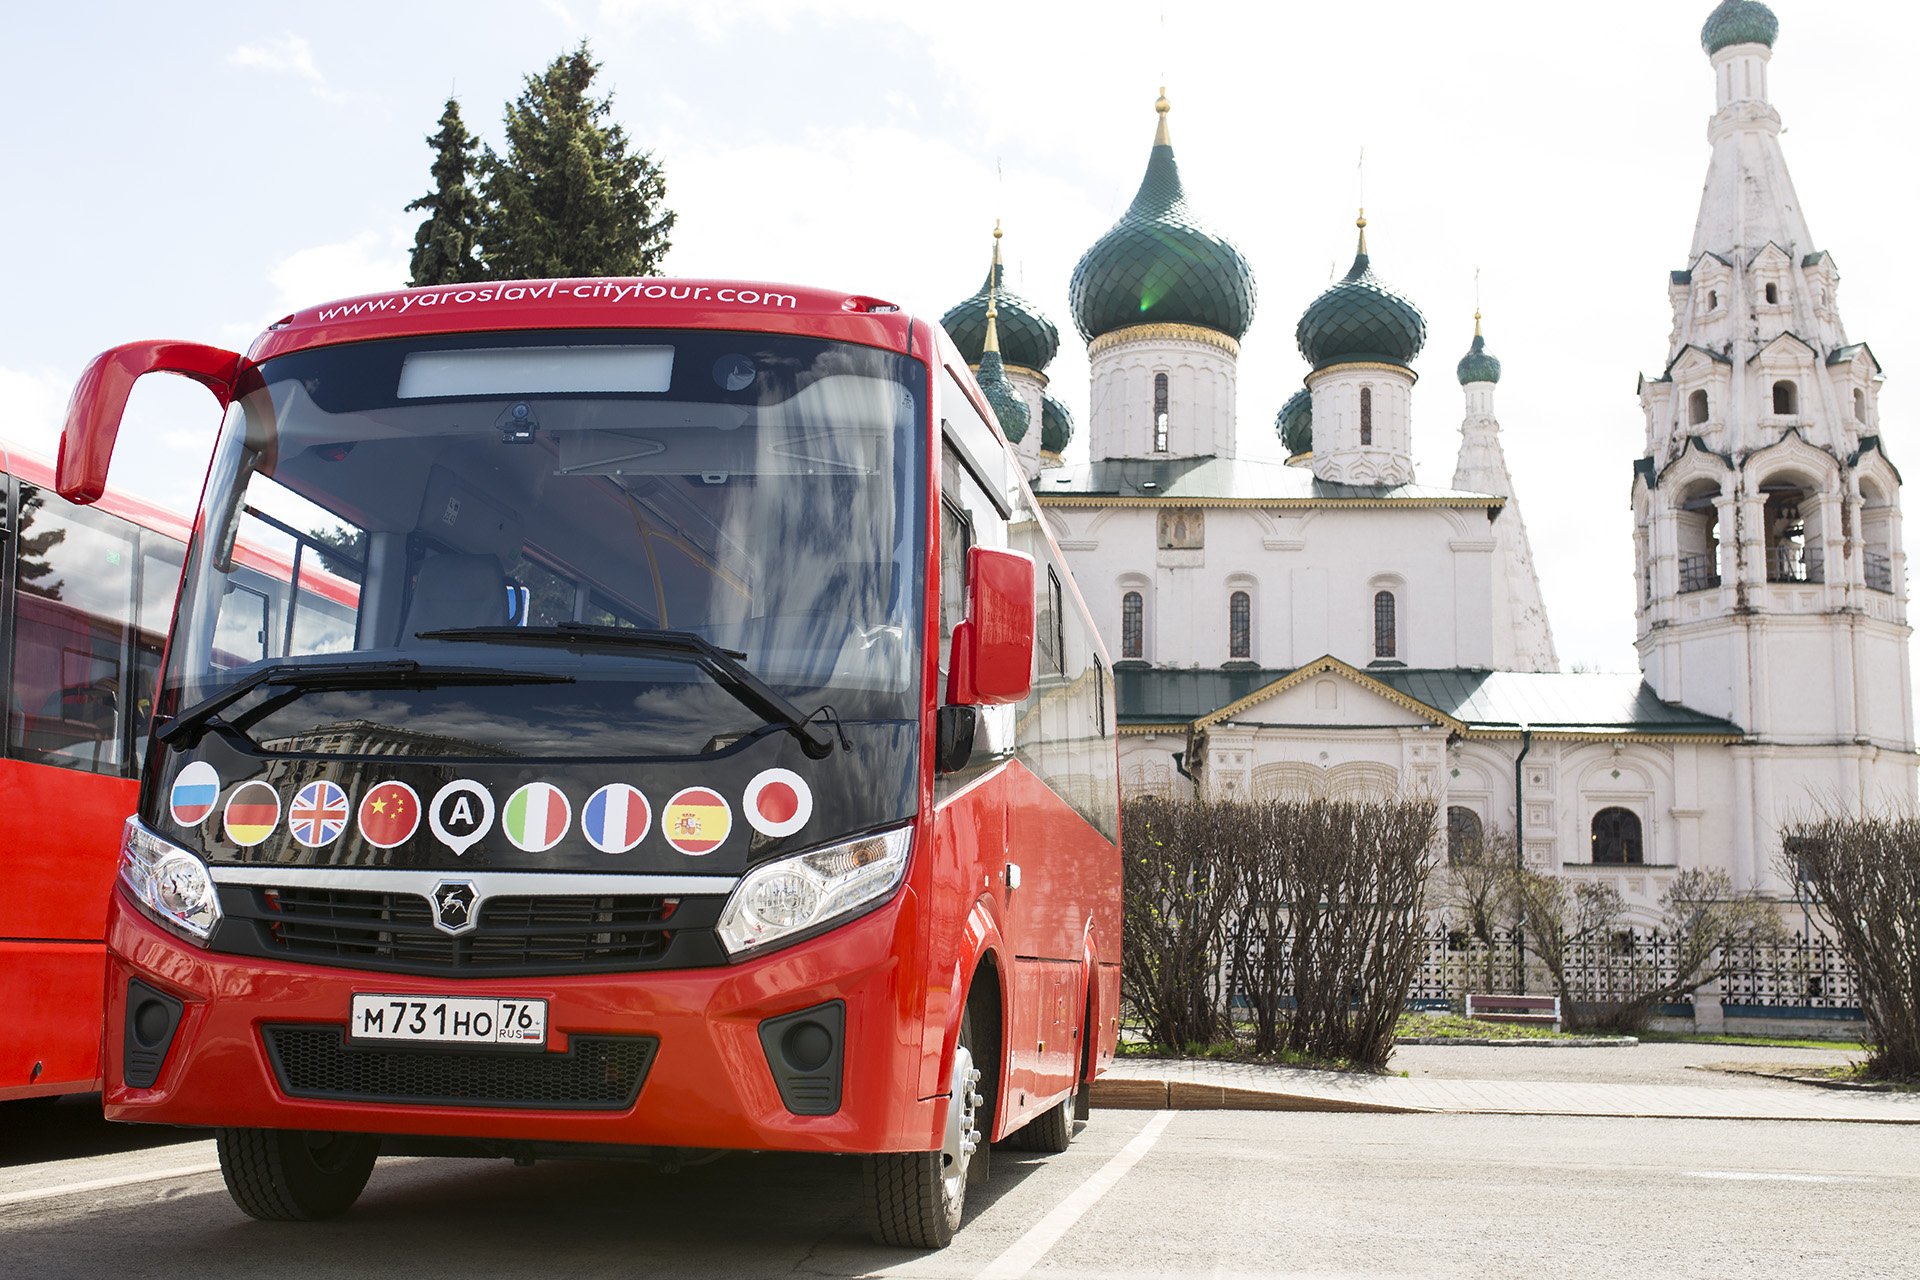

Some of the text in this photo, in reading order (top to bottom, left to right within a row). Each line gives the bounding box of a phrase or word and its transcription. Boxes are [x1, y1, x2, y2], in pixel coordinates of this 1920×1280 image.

[319, 281, 797, 322] www.yaroslavl-citytour.com
[448, 796, 474, 825] A
[502, 1004, 533, 1029] 76
[500, 1028, 522, 1039] RUS
